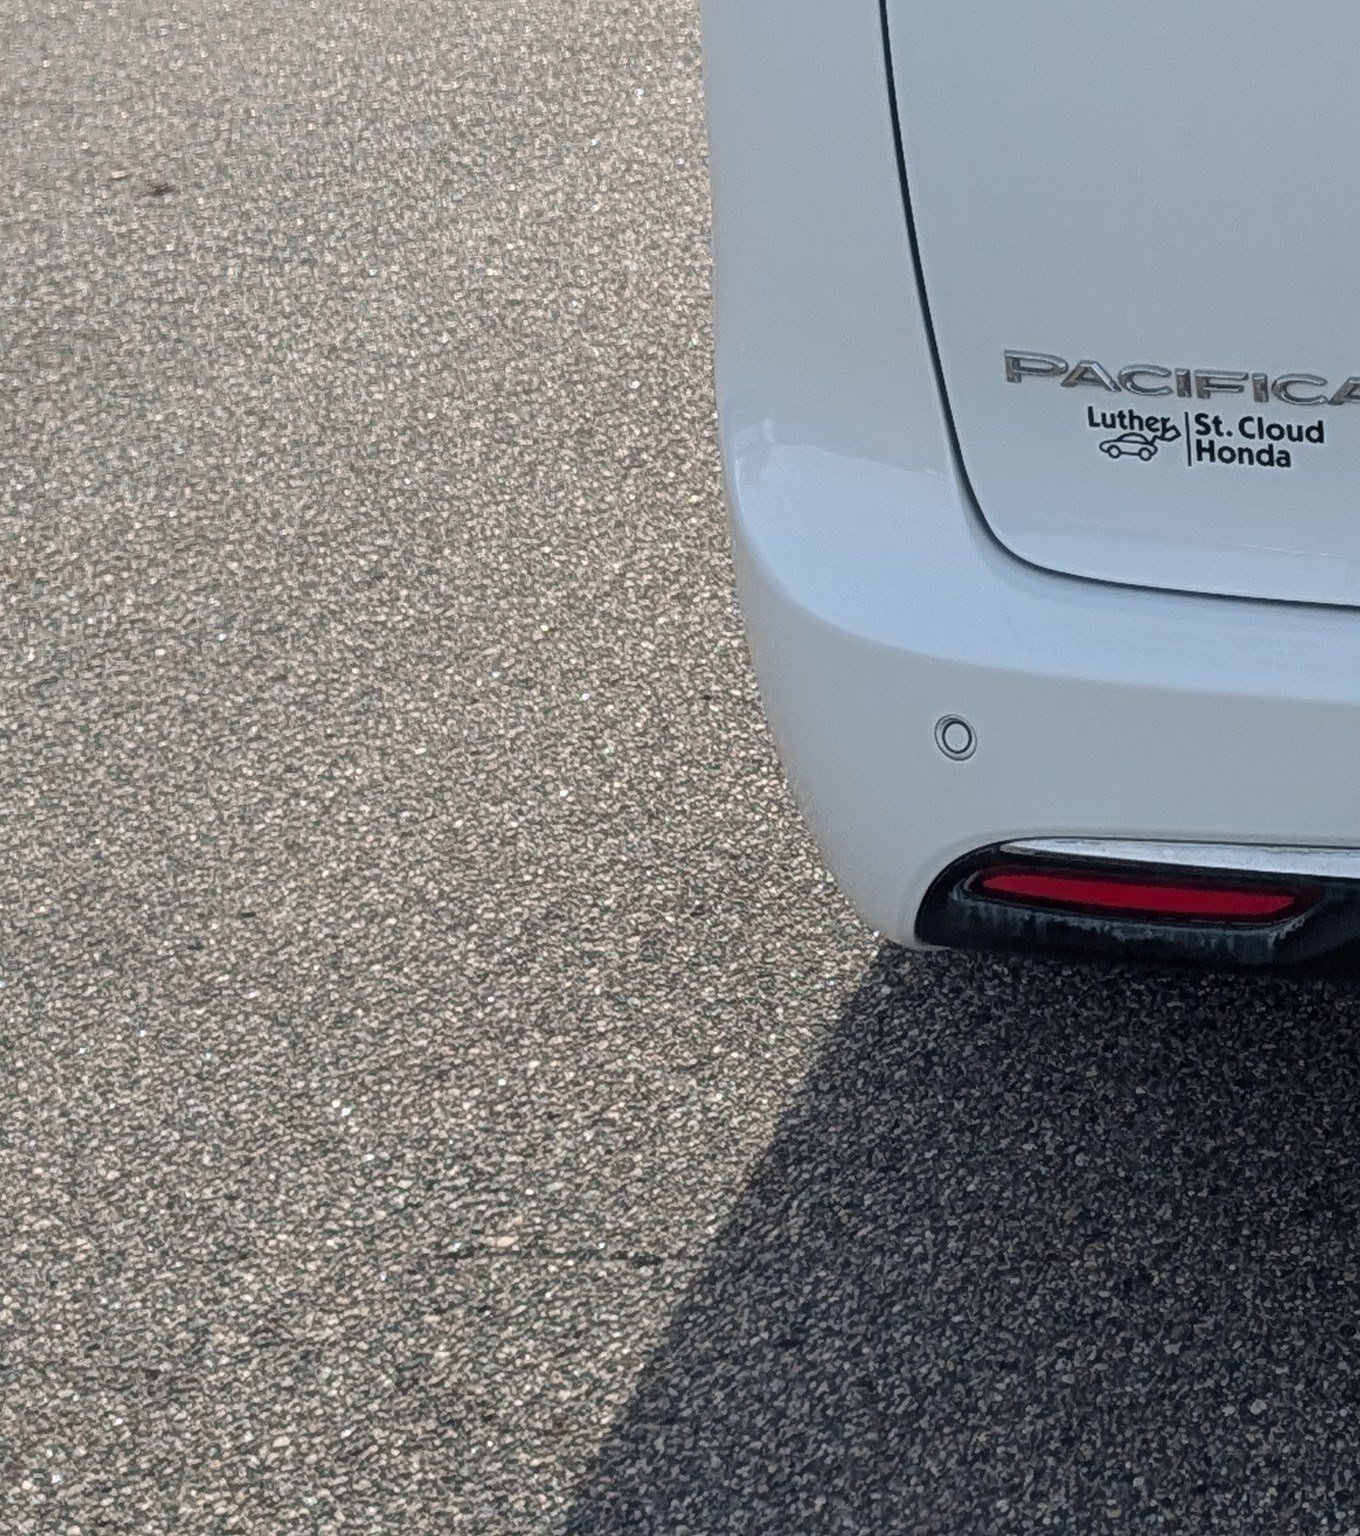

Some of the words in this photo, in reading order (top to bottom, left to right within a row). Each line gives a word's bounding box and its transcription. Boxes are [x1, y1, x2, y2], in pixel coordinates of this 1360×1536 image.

[1087, 406, 1172, 434] Luther
[1195, 413, 1233, 438] St.
[1238, 416, 1325, 444] Cloud
[1196, 439, 1292, 469] Honda
